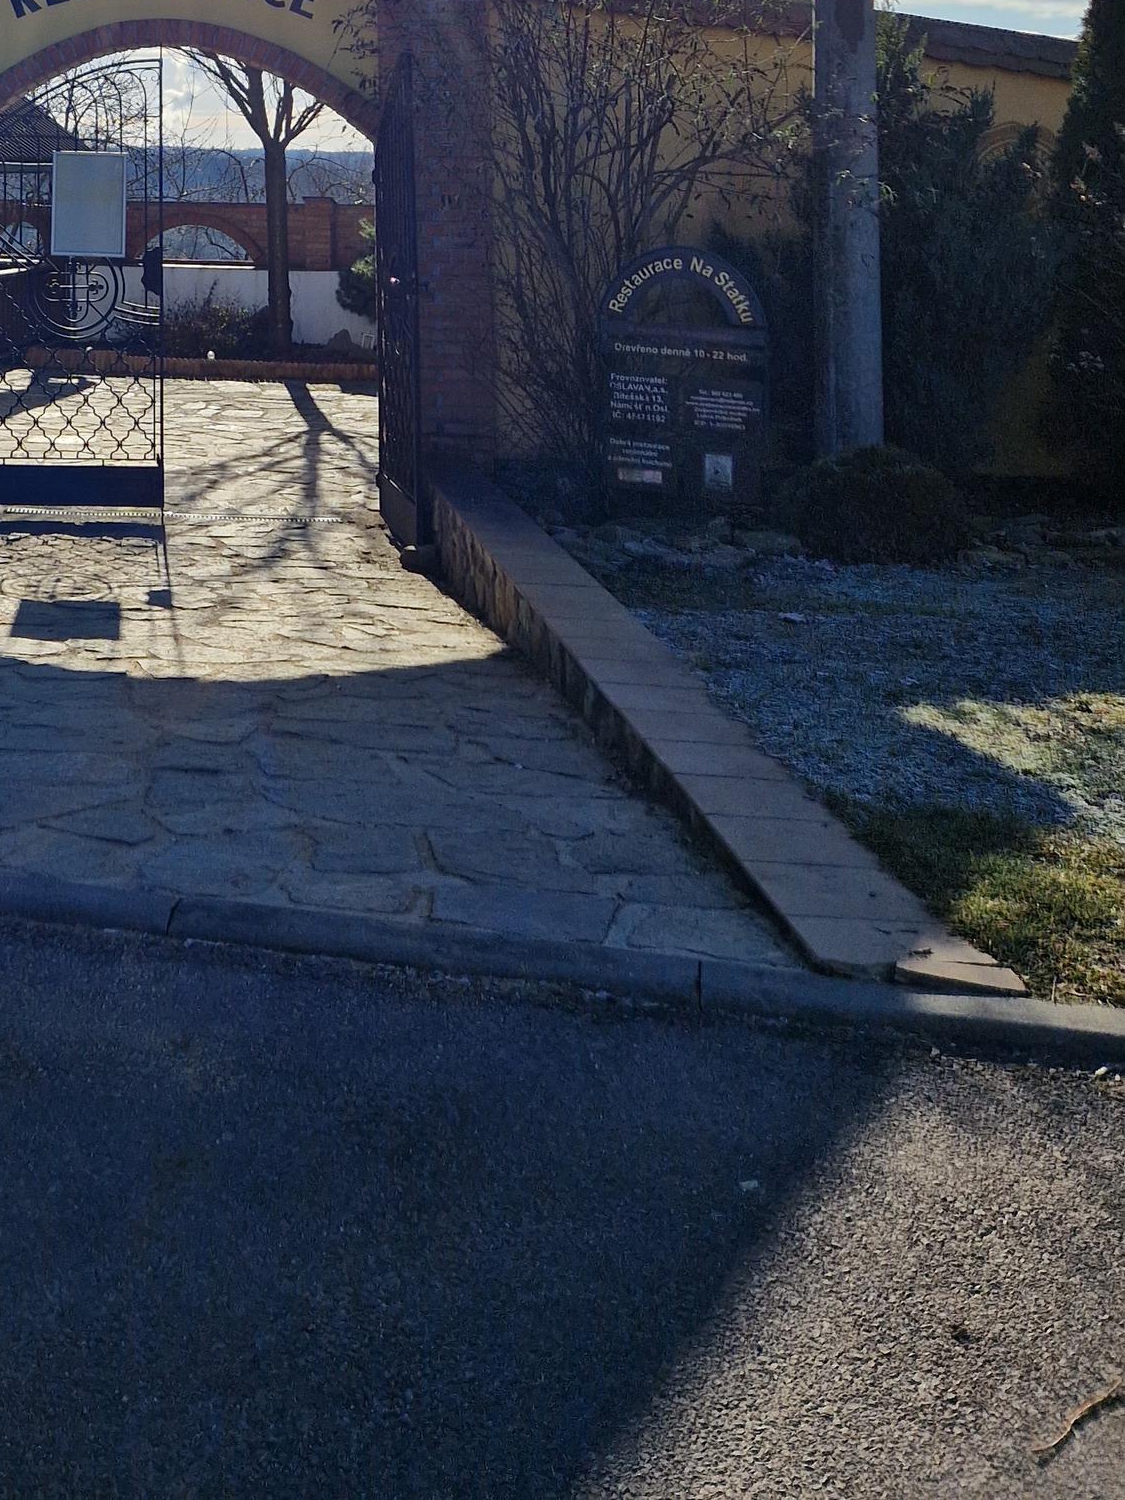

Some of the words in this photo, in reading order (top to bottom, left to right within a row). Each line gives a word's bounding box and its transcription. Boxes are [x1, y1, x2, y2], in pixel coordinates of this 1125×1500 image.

[609, 258, 683, 313] Restaurace
[690, 256, 713, 278] Na
[714, 271, 754, 323] Statku
[694, 349, 705, 358] 10
[712, 351, 725, 360] 22
[727, 352, 748, 362] hod.
